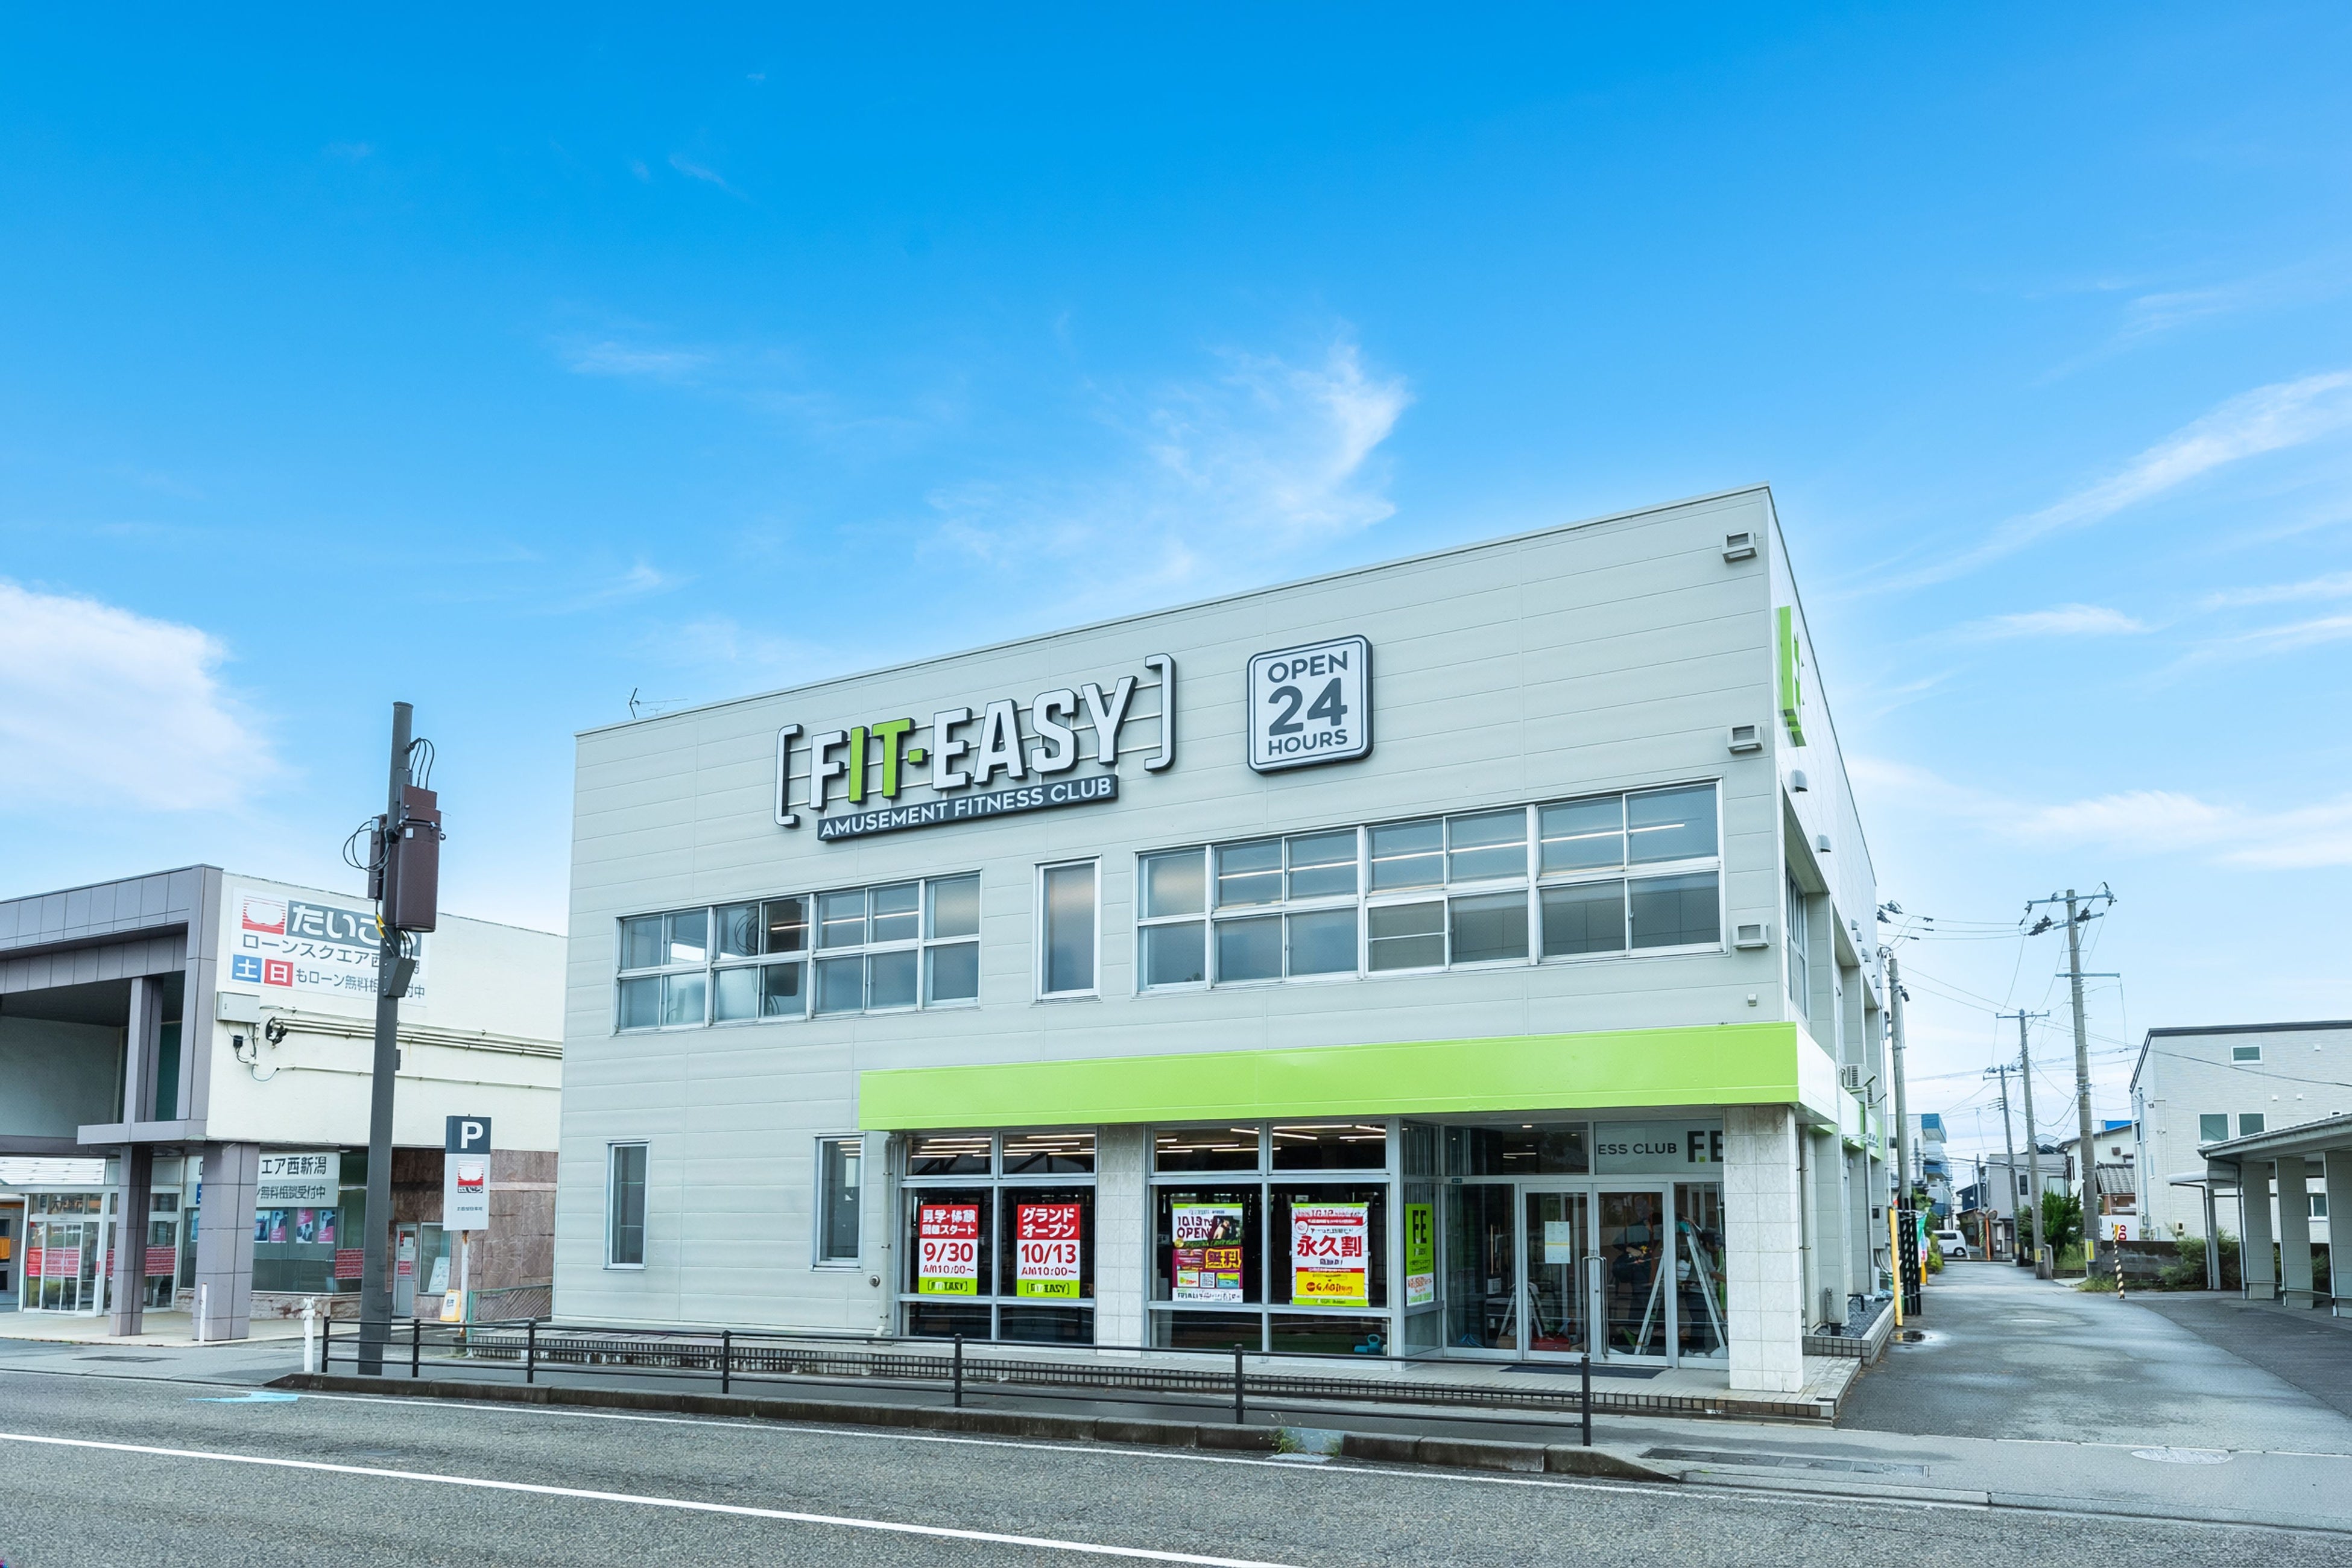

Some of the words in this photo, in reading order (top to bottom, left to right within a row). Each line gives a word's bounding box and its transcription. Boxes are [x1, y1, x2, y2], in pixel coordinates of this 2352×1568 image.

[1268, 650, 1348, 683] OPEN
[1268, 677, 1348, 736] 24
[1268, 729, 1348, 756] HOURS
[821, 802, 947, 838] AMUSEMENT
[955, 790, 1043, 818] FITNESS
[1051, 777, 1111, 802] CLUB
[460, 1121, 484, 1149] P
[1633, 1143, 1677, 1154] CLUB
[1022, 1207, 1075, 1223] グランド
[1022, 1222, 1075, 1238] オープン
[1177, 1227, 1209, 1239] OPEN
[924, 1242, 973, 1262] 9/30
[1021, 1244, 1076, 1264] 10/13
[1297, 1235, 1362, 1257] 永久割
